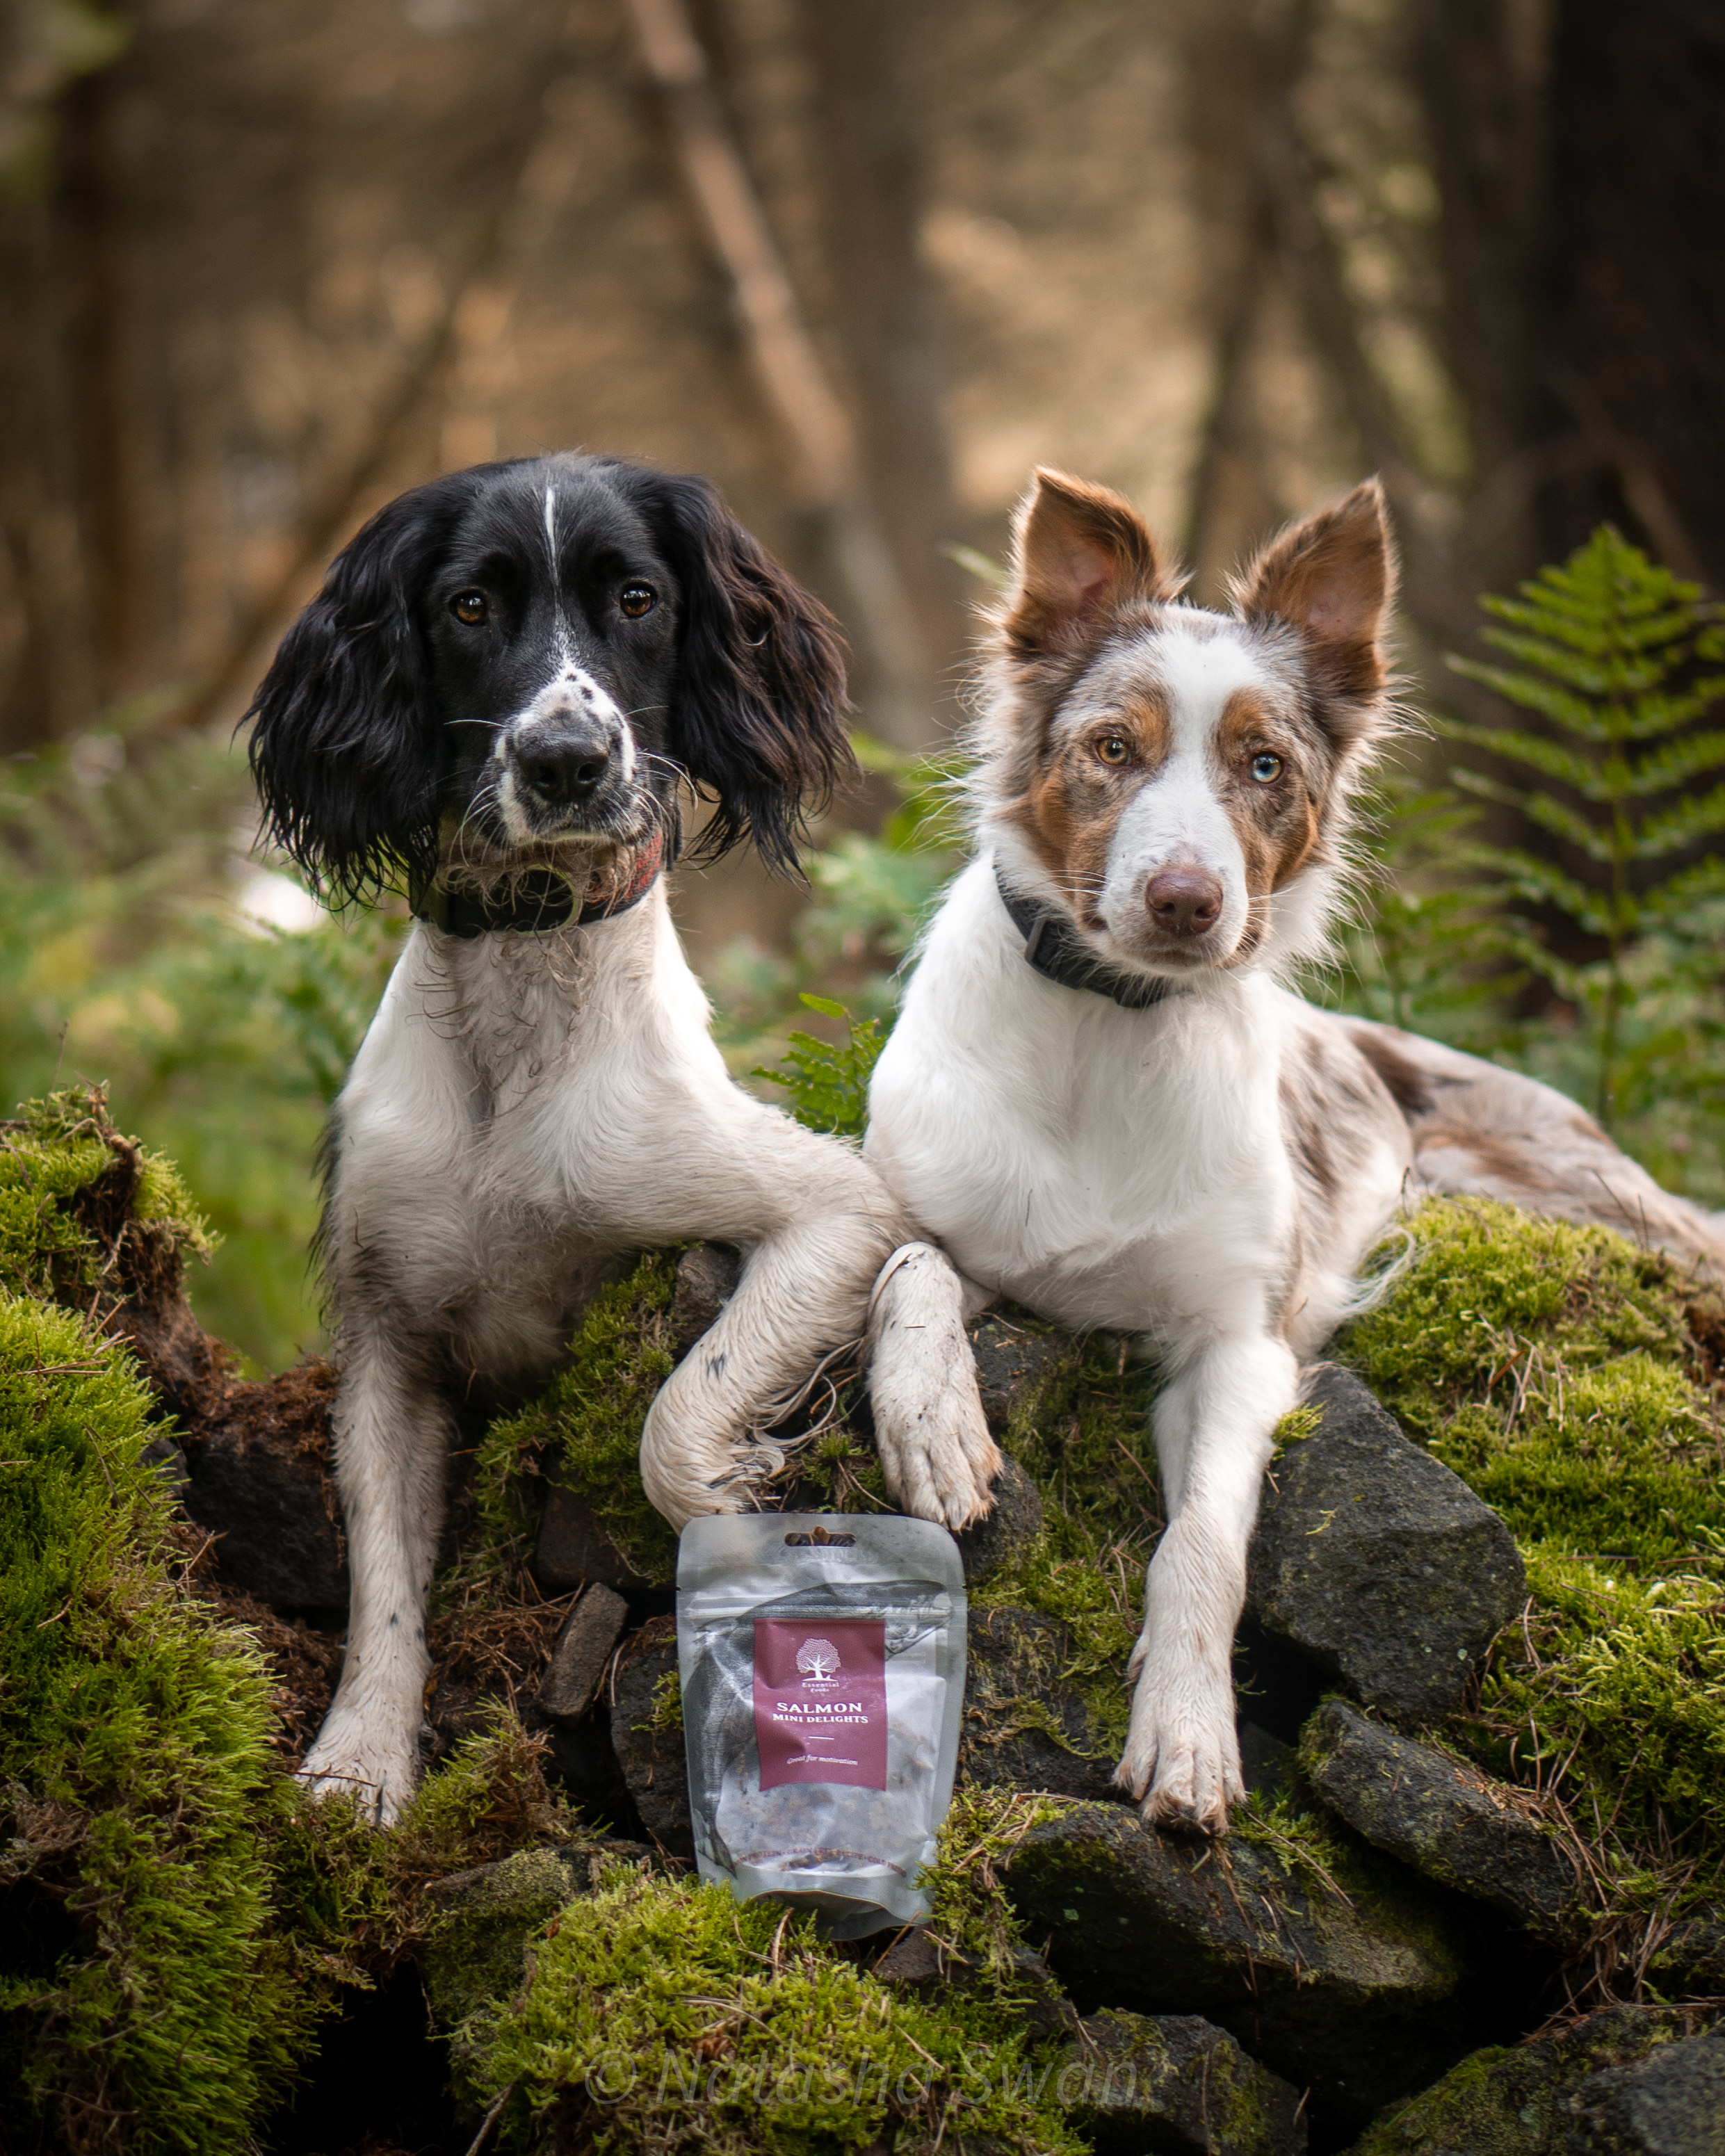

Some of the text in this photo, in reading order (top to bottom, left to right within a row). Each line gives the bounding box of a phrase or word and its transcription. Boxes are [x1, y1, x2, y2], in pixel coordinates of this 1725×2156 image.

[777, 1702, 862, 1713] SALMON
[772, 1713, 803, 1722] MINI
[786, 1754, 858, 1765] Great for motivation
